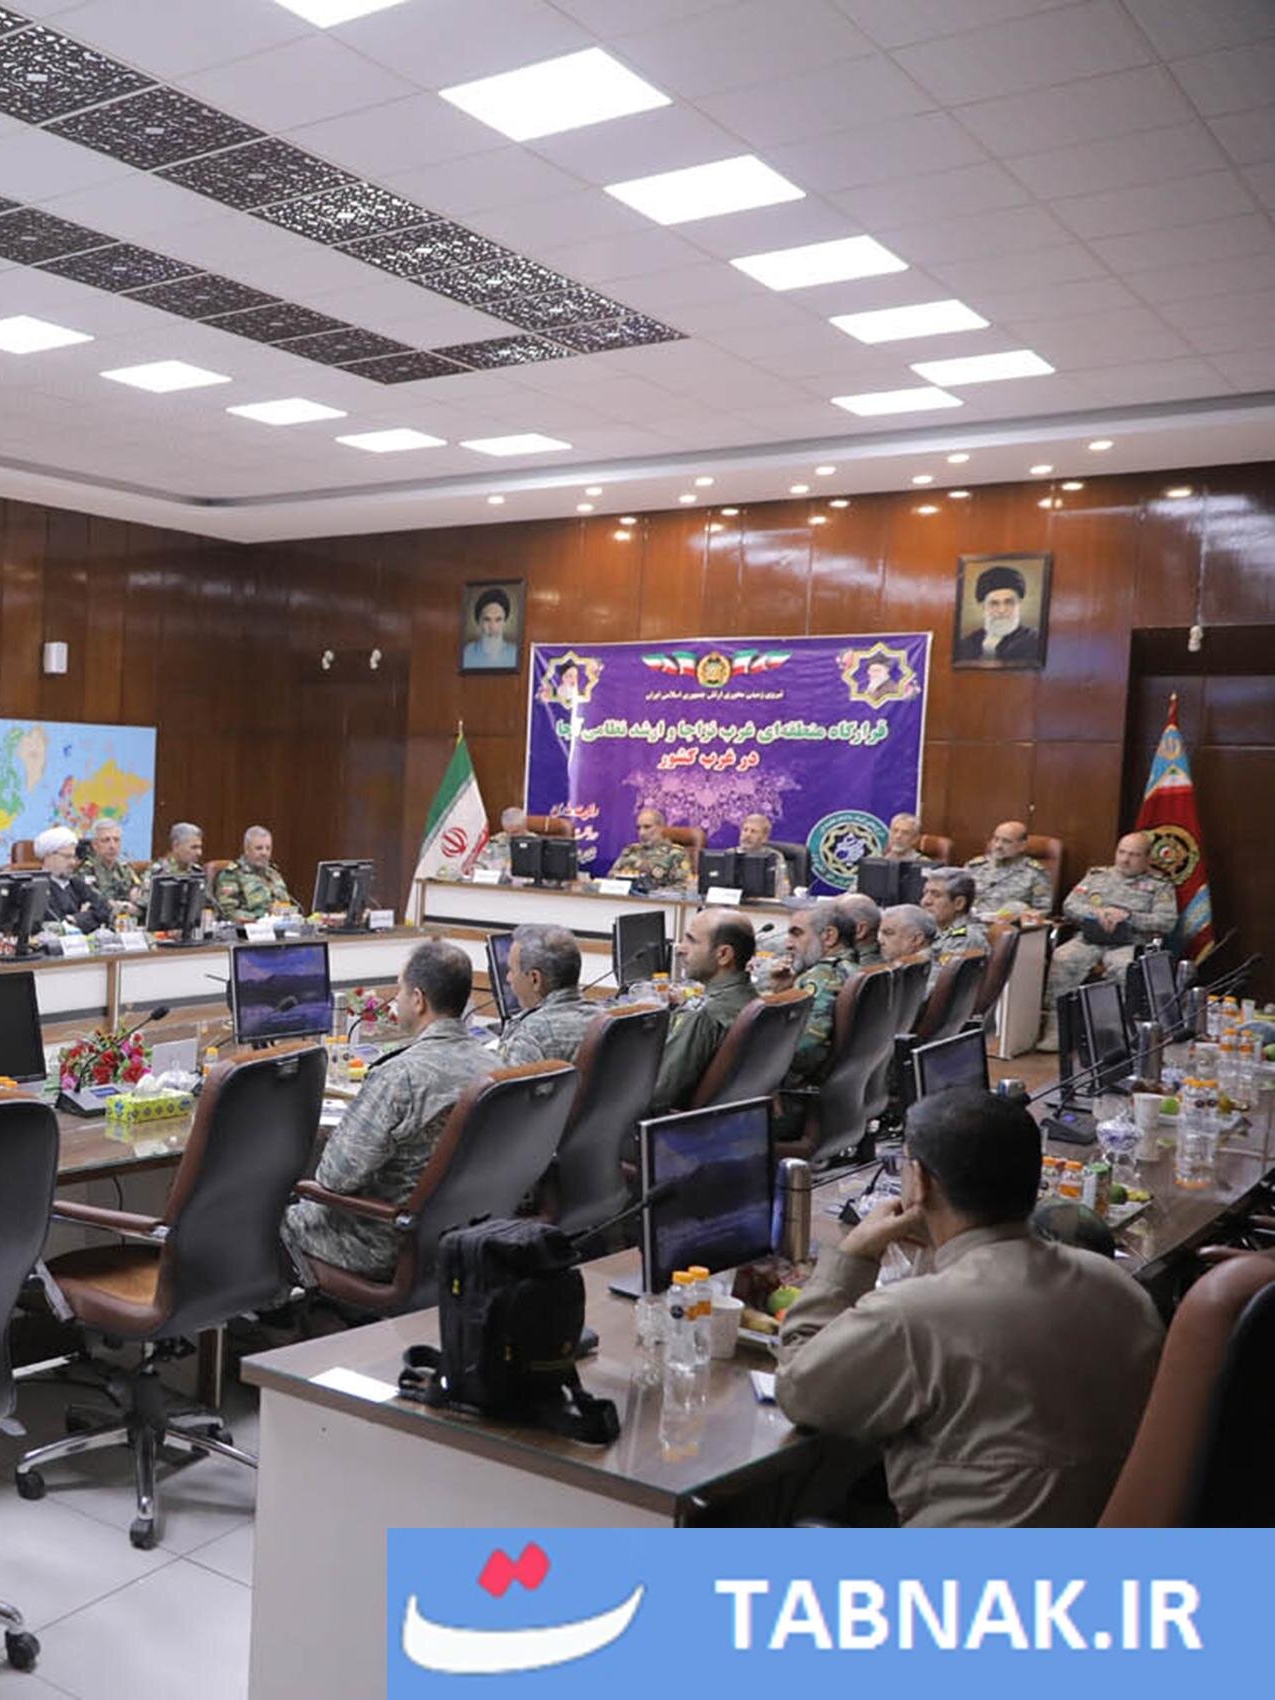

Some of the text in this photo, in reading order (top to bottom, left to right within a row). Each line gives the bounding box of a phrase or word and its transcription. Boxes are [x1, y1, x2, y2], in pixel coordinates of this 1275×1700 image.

[581, 719, 627, 741] نظامی
[629, 720, 665, 743] ارشد
[665, 725, 676, 743] و
[719, 720, 756, 744] غرب
[828, 719, 888, 745] قرارگاه
[657, 747, 759, 772] در غرب کشور
